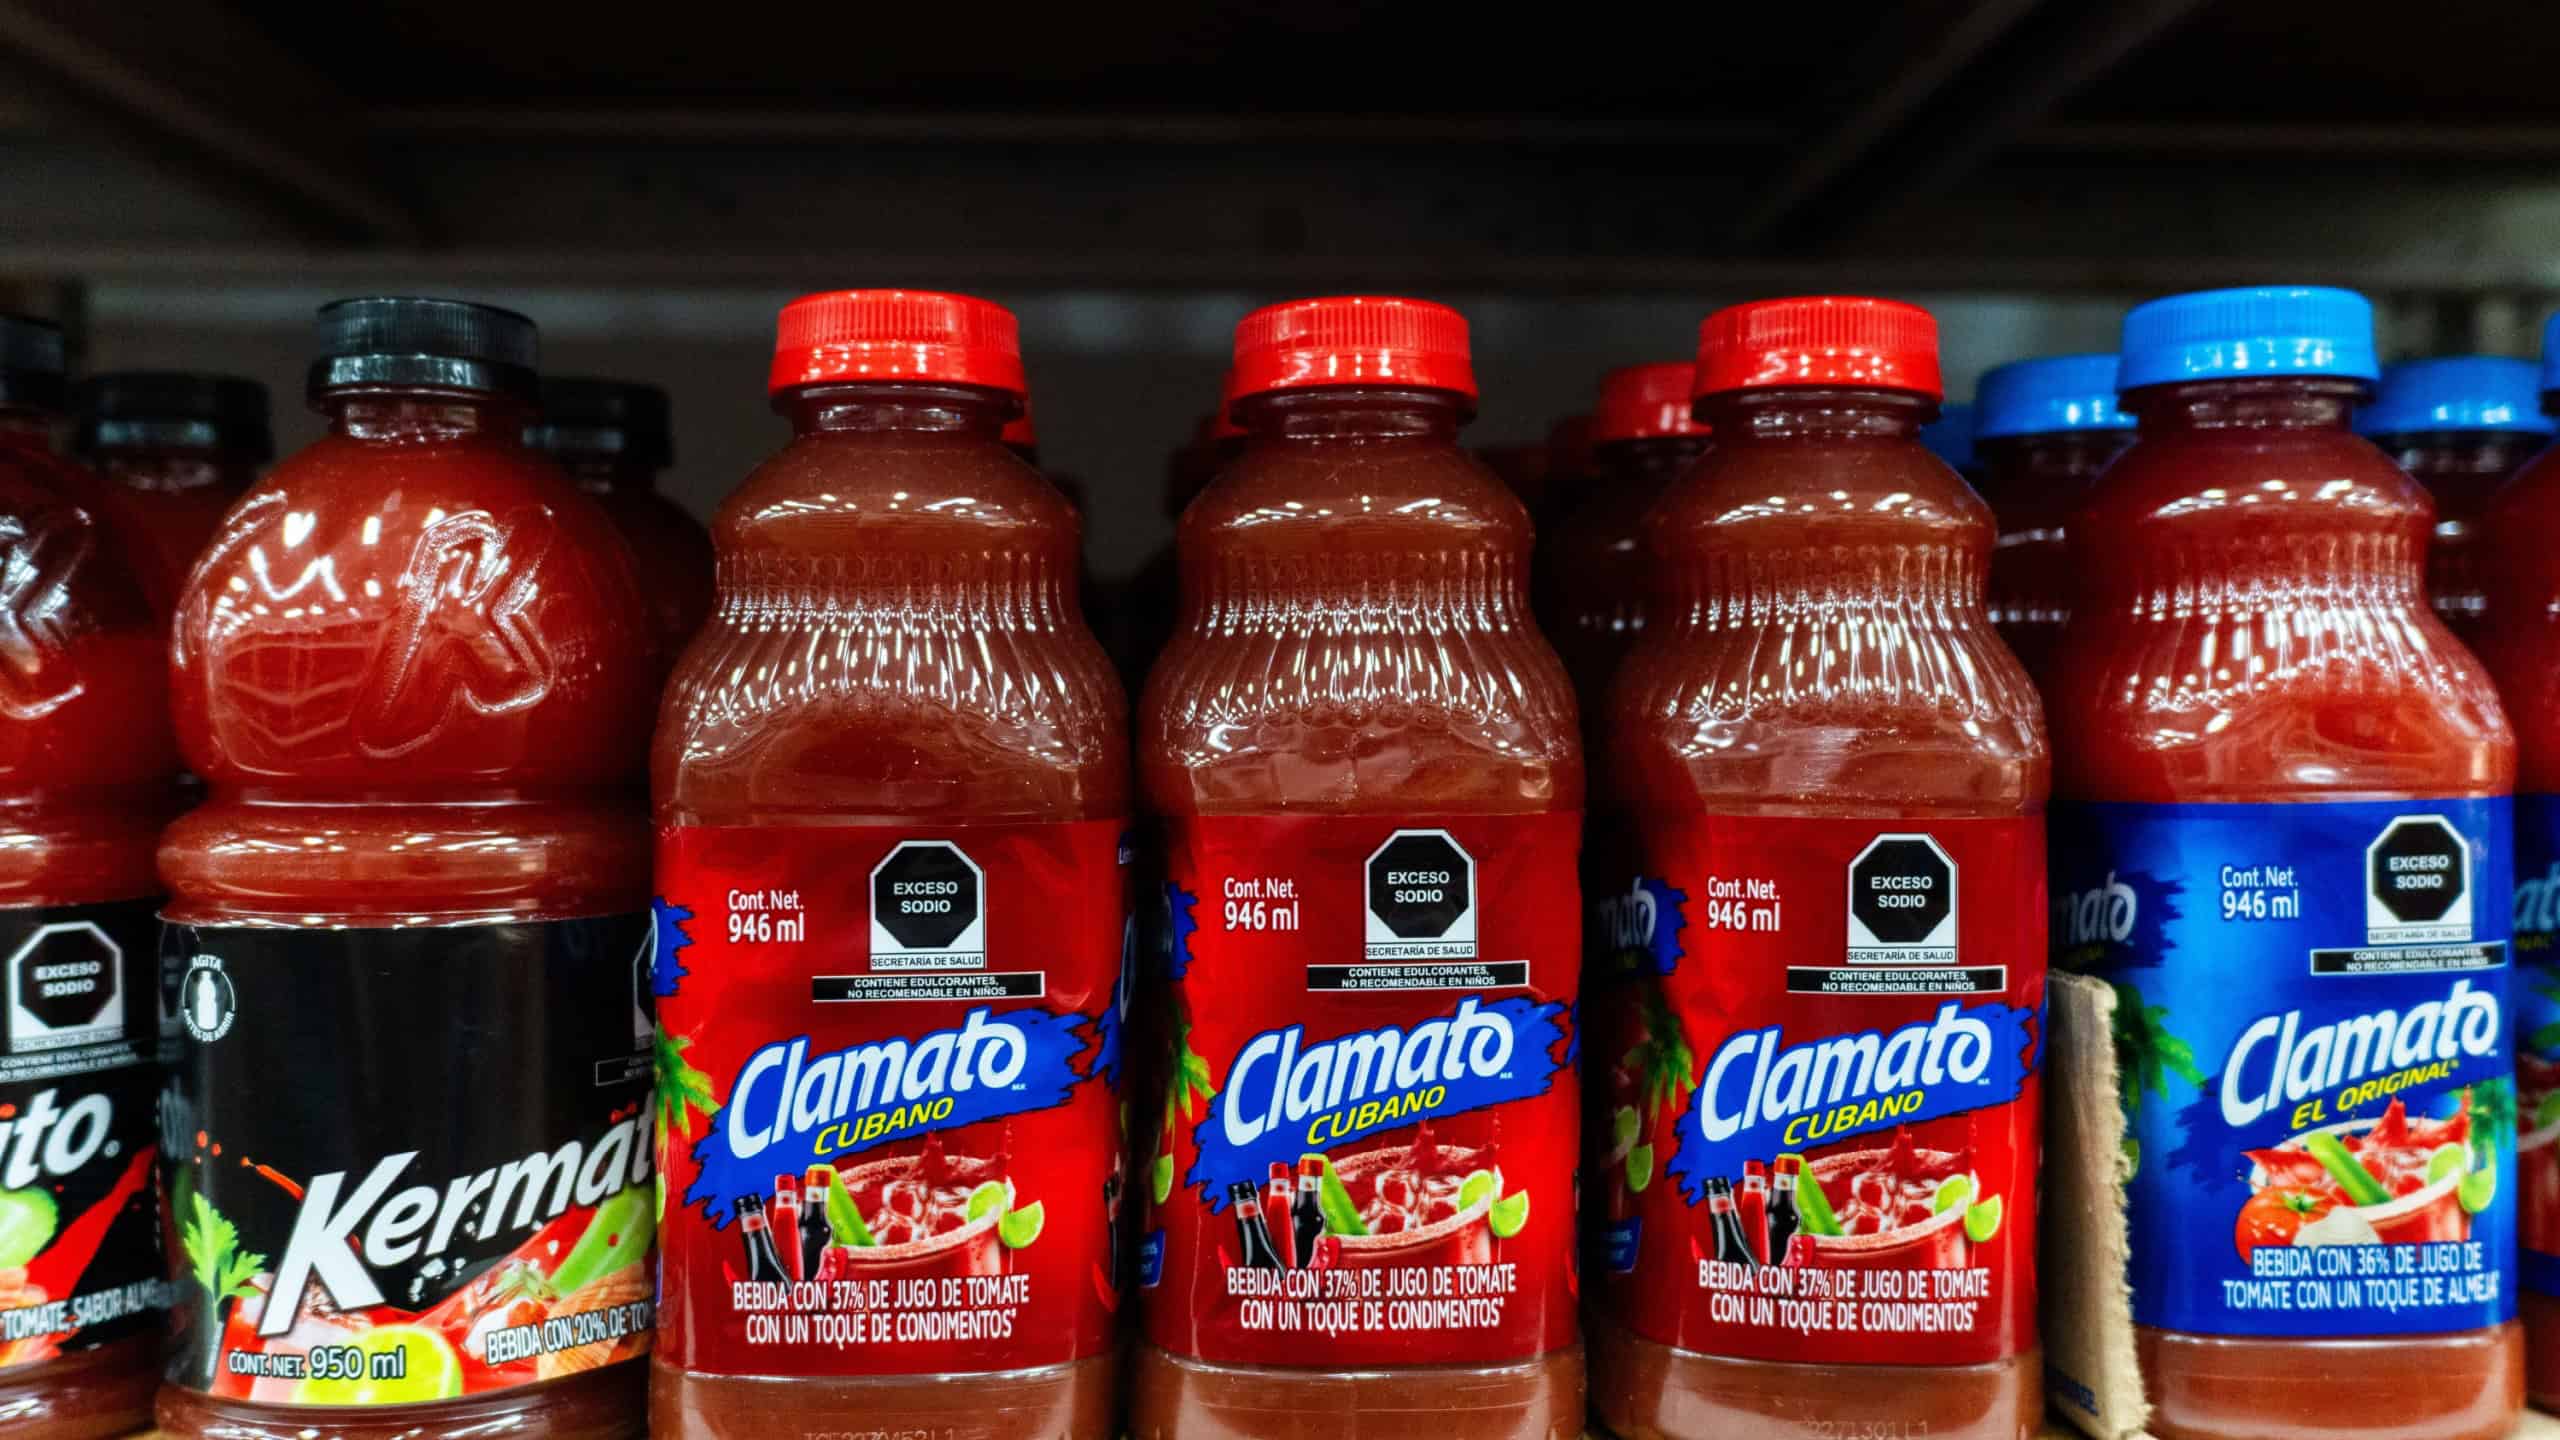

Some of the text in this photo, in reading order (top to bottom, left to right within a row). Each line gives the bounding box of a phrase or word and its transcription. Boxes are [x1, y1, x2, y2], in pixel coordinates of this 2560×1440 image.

[1387, 870, 1450, 885] EXCESO
[2389, 855, 2449, 871] EXCESO
[894, 881, 957, 896] EXCESO
[1394, 889, 1443, 904] SODIO
[1871, 876, 1933, 891] EXCESO
[2396, 874, 2443, 889] SODIO
[901, 899, 951, 914] SODIO
[1224, 900, 1299, 931] 946 ml
[1708, 901, 1781, 932] 946 ml
[1878, 894, 1926, 909] SODIO
[2223, 889, 2299, 919] 946 ml
[728, 911, 805, 943] 946 ml
[934, 957, 946, 966] DE
[950, 956, 982, 966] SALUD
[1427, 946, 1440, 955] DE
[1443, 945, 1473, 955] SALUD
[35, 961, 101, 981] EXCESO
[854, 978, 907, 988] CONTIENE
[1341, 975, 1496, 988] NO RECOMENDABLE EN NIÑOS
[1349, 968, 1401, 977] CONTIENE
[1822, 980, 1976, 992] NO RECOMENDABLE EN NIÑOS
[1829, 971, 1882, 981] CONTIENE
[43, 979, 95, 997] SODIO
[848, 985, 1006, 998] NO RECOMENDABLE EN NIÑOS
[2221, 979, 2499, 1126] Clamato
[728, 1009, 1027, 1159] Clamato
[1223, 999, 1514, 1147] Clamato
[1701, 1004, 1992, 1143] Clamato
[814, 1097, 954, 1155] CUBANO
[1306, 1085, 1446, 1146] CUBANO
[1783, 1090, 1925, 1145] CUBANO
[2291, 1098, 2326, 1130] EL
[0, 1088, 112, 1190] to
[2253, 1242, 2482, 1277] BEBIDA CON 36% DE JUGO DE
[733, 1275, 1030, 1311] BEBIDA CON 37% DE JUGO DE TOMATE
[1227, 1263, 1517, 1299] BEBIDA CON 37% DE JUGO DE TOMATE
[1699, 1260, 1990, 1298] BEBIDA CON 37% DE JUGO DE TOMATE
[73, 1290, 123, 1326] SABOR
[126, 1275, 176, 1314] ALME
[2223, 1280, 2291, 1309] TOMATE
[2296, 1280, 2331, 1309] CON
[2337, 1280, 2360, 1308] UN
[2365, 1278, 2419, 1313] TOQUE
[2423, 1277, 2443, 1304] DE
[1240, 1299, 1274, 1330] CON
[1278, 1301, 1301, 1330] UN
[1305, 1301, 1358, 1338] TOQUE
[1363, 1300, 1384, 1330] DE
[1711, 1294, 1744, 1323] CON
[1750, 1297, 1773, 1326] UN
[1778, 1299, 1832, 1335] TOQUE
[1837, 1301, 1857, 1330] DE
[487, 1324, 542, 1365] BEBIDA
[544, 1317, 573, 1350] CON
[575, 1311, 607, 1344] 20%
[609, 1306, 628, 1337] DE
[746, 1314, 780, 1344] CON
[785, 1314, 808, 1344] UN
[813, 1314, 866, 1350] TOQUE
[871, 1313, 892, 1342] DE
[228, 1347, 404, 1378] CONT. NET. 950 ml
